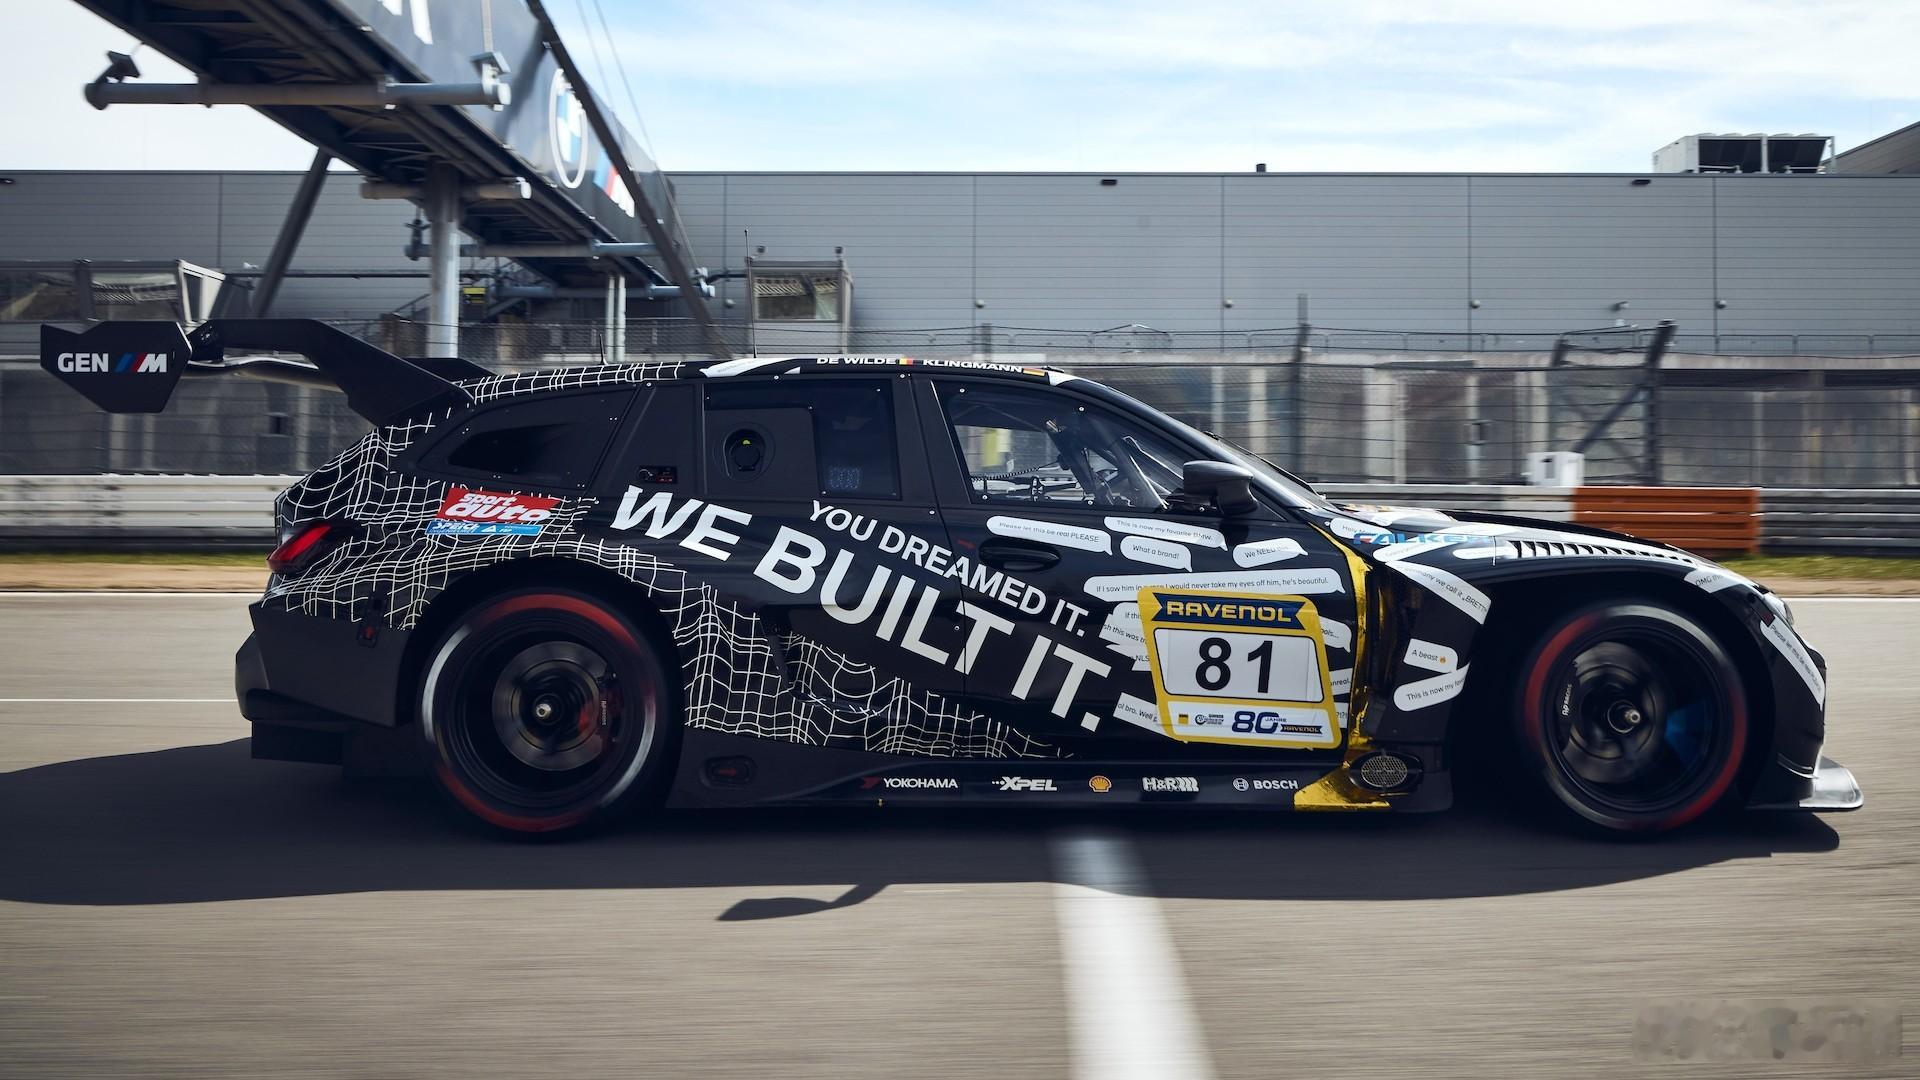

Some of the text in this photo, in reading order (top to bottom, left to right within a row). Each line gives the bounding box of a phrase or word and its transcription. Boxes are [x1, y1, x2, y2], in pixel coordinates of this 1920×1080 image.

[57, 352, 109, 373] GEN
[816, 356, 897, 365] DE WILDE
[923, 358, 1023, 373] KLINGMANN
[459, 492, 517, 506] sport
[444, 501, 552, 522] auto
[1117, 520, 1131, 528] This
[1070, 532, 1099, 543] PLEASE
[1133, 544, 1150, 554] What
[1157, 549, 1180, 560] brand!
[1245, 550, 1256, 558] We
[809, 499, 1090, 635] YOU DREAMED IT.
[1169, 582, 1190, 590] would
[1210, 580, 1226, 588] take
[1227, 581, 1238, 589] my
[1256, 578, 1265, 586] off
[1266, 579, 1281, 587] him,
[1282, 577, 1297, 585] he's
[1298, 576, 1328, 585] beautiful.
[1435, 578, 1446, 587] we
[1445, 584, 1458, 595] call
[1695, 575, 1713, 586] OMG
[609, 484, 1112, 732] WE BUILT IT.
[1166, 601, 1292, 622] RAVENOL
[1112, 627, 1125, 636] this
[1125, 632, 1139, 641] was
[1412, 649, 1439, 662] A beast
[1195, 637, 1273, 694] 81
[1406, 691, 1422, 701] This
[1430, 686, 1444, 695] now
[1444, 683, 1454, 692] my
[1139, 709, 1153, 721] Well
[1231, 710, 1280, 734] 80
[883, 777, 959, 789] YOKOHAMA
[999, 776, 1058, 791] XPEL
[1253, 779, 1299, 790] BOSCH
